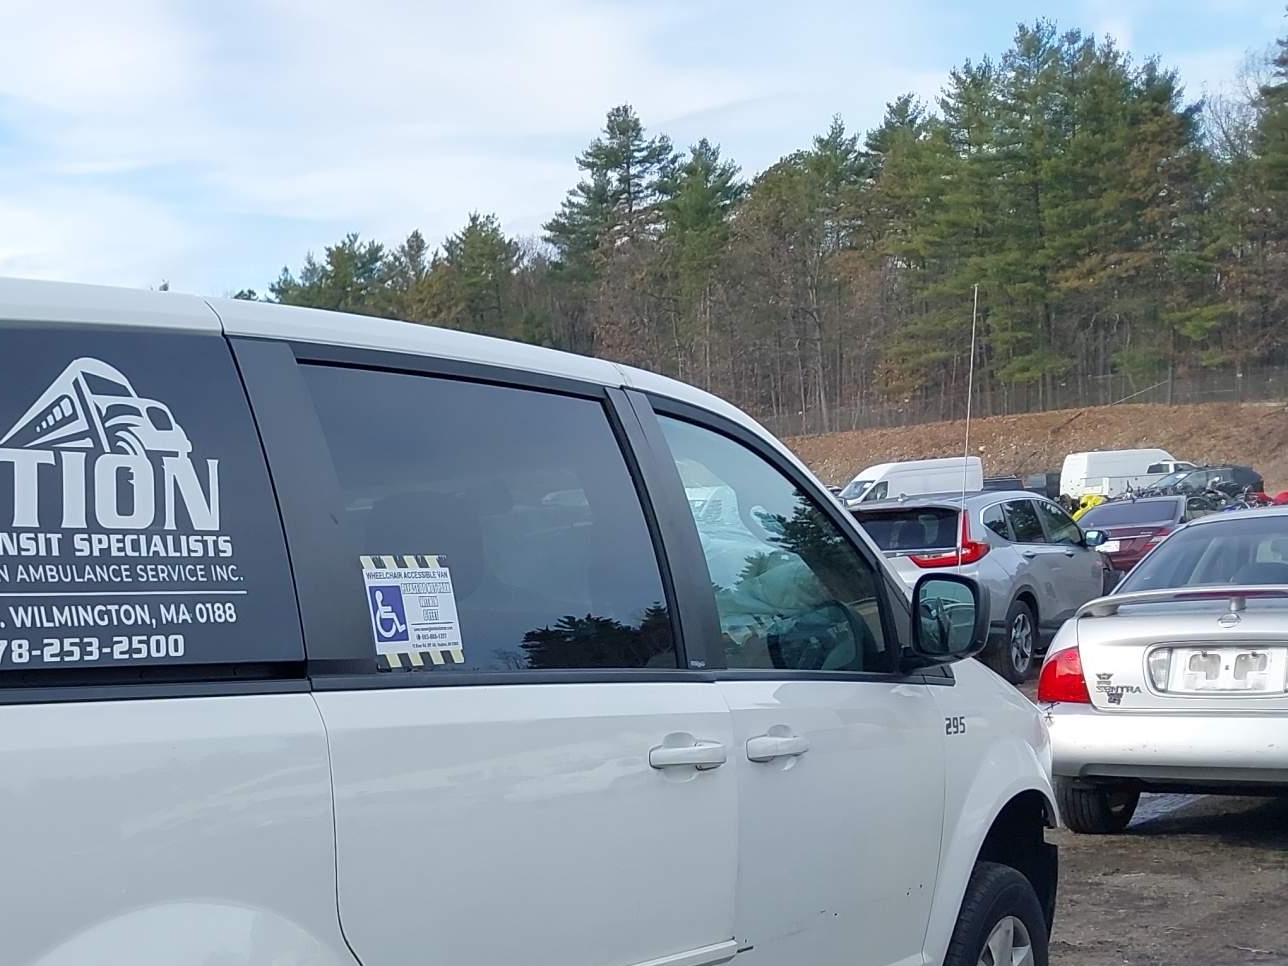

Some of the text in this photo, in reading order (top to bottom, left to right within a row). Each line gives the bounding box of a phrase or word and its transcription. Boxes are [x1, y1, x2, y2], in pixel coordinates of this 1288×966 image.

[73, 533, 233, 557] SPECIALISTS
[16, 564, 133, 583] AMBULANCE
[137, 564, 208, 582] SERVICE
[211, 564, 244, 582] INC.
[404, 571, 437, 579] ACCESSIBLE
[9, 604, 157, 629] WILMINGTON,
[160, 603, 192, 624] MA
[195, 602, 237, 624] 0188
[945, 716, 966, 735] 295
